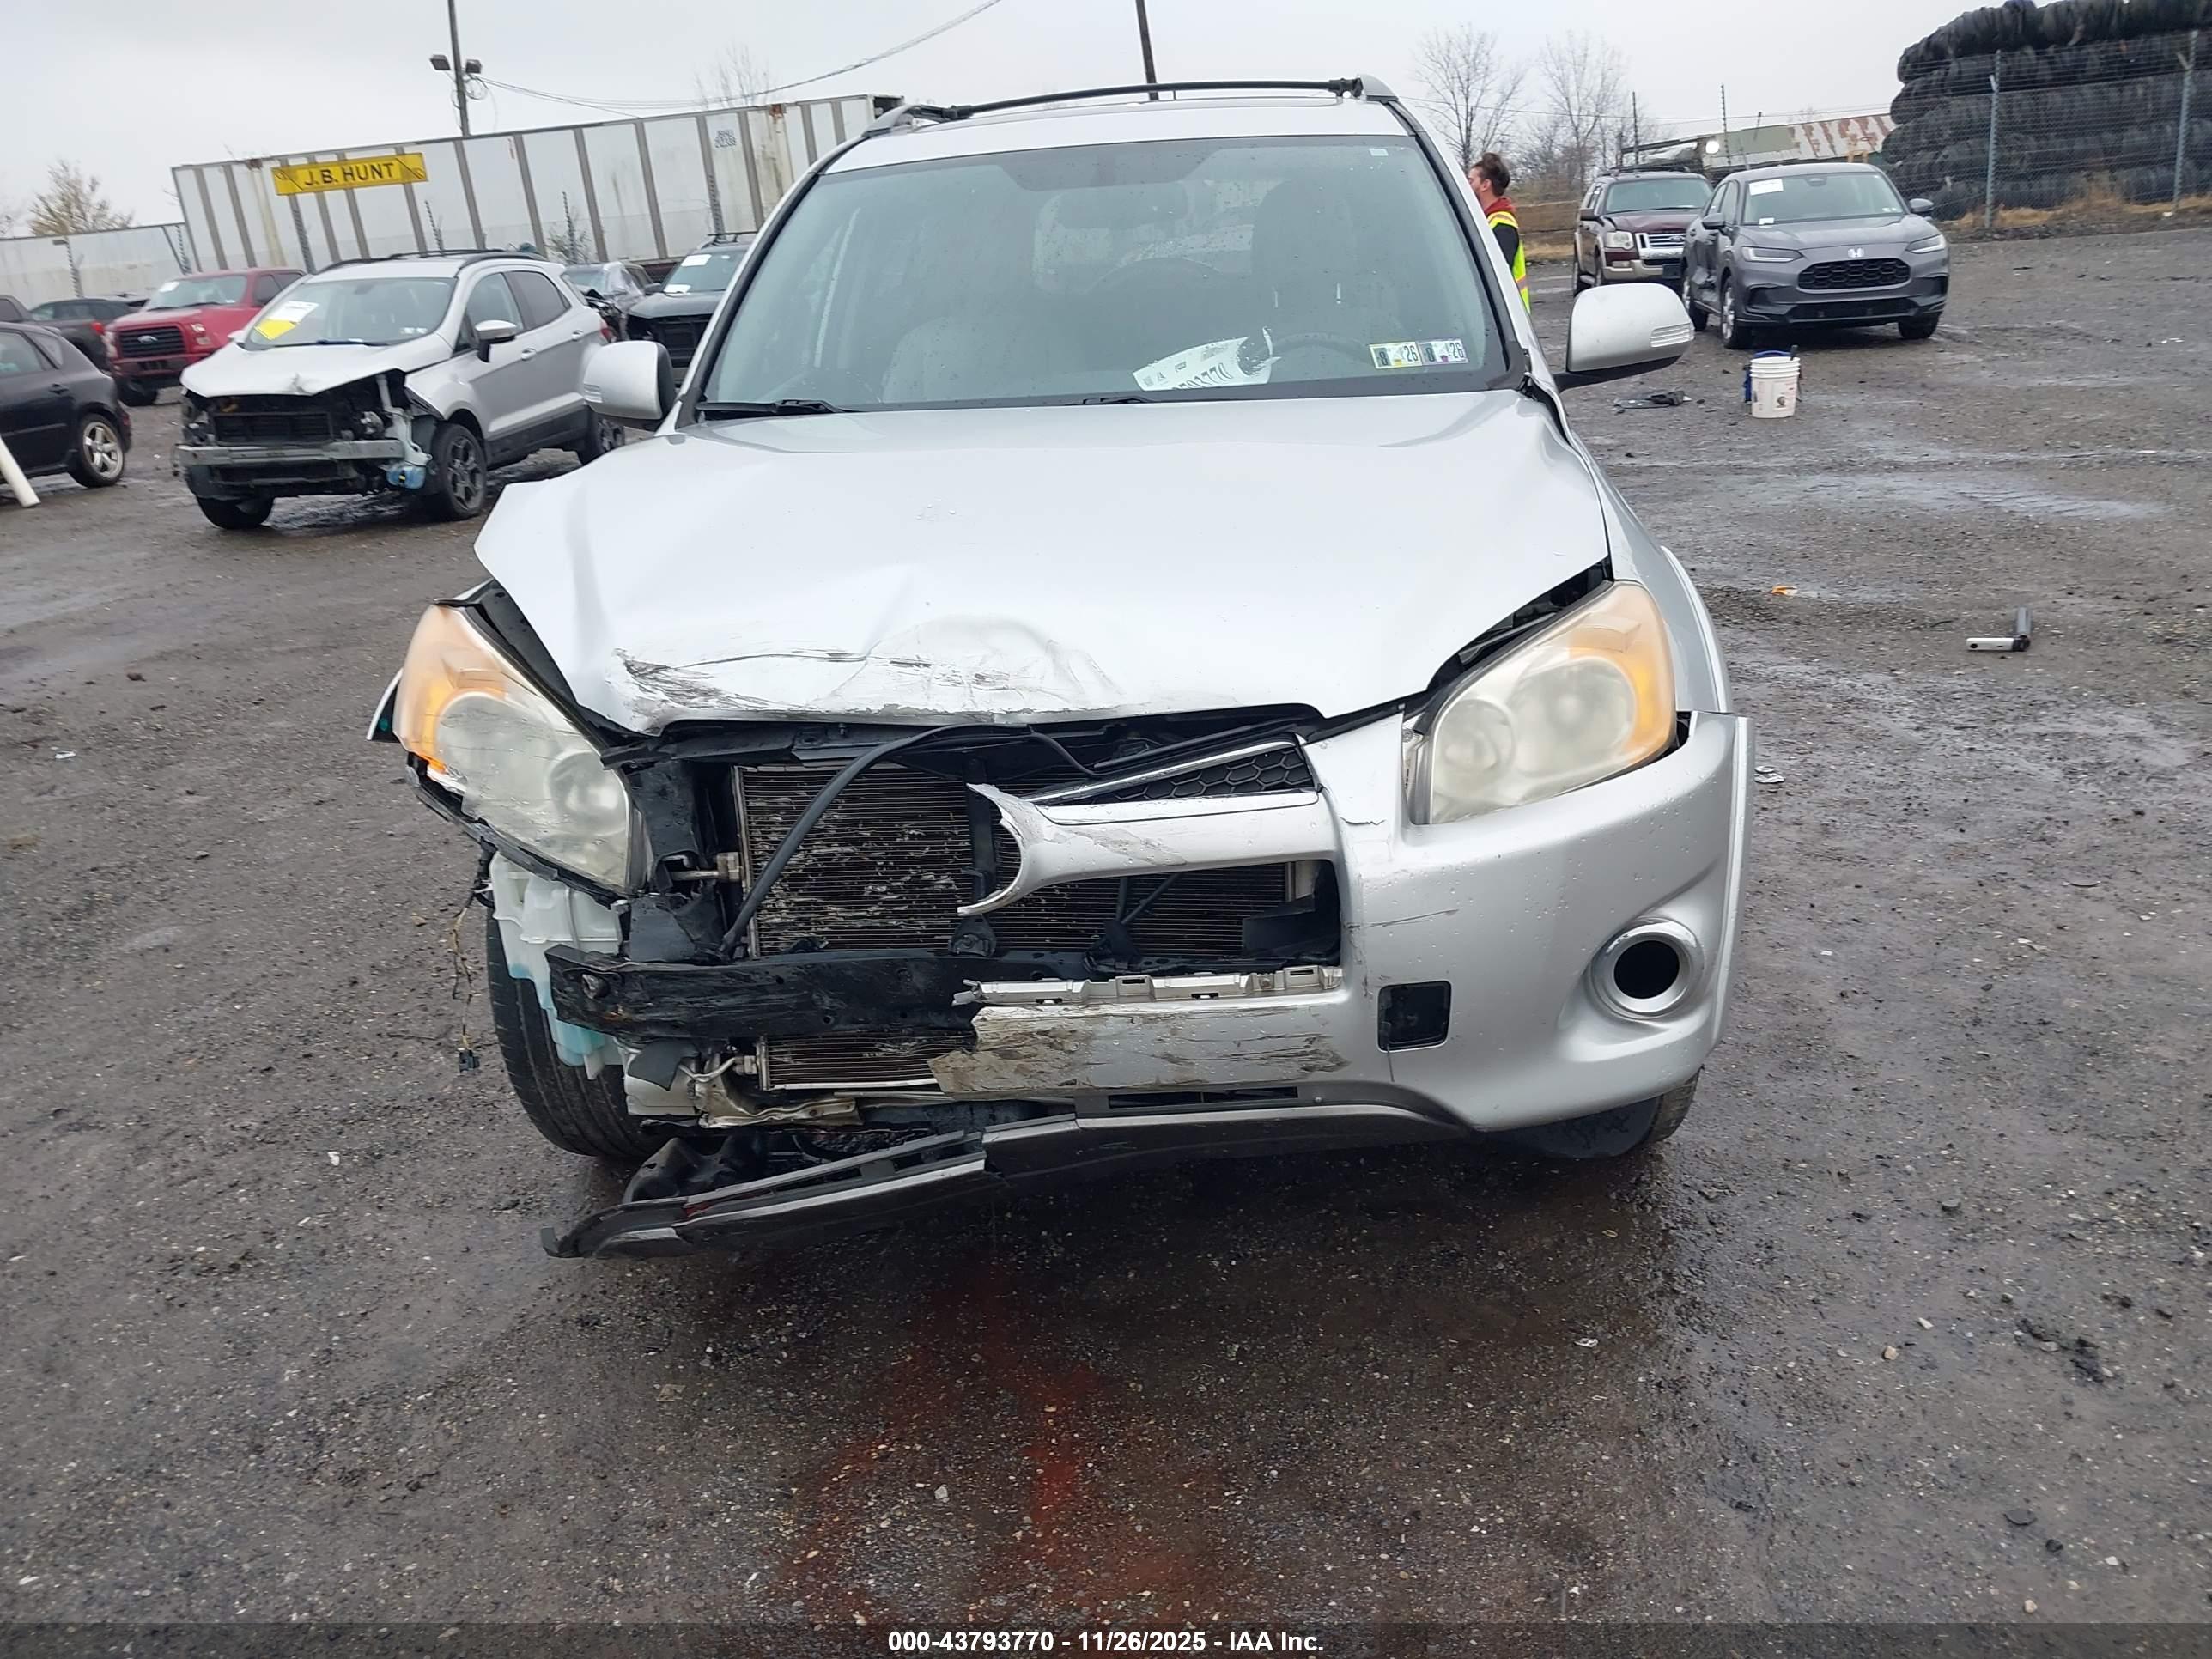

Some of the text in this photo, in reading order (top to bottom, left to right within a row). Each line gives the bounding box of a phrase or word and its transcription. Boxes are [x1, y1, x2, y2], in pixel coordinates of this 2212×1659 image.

[304, 162, 394, 186] J.B. HUNT
[1403, 345, 1419, 362] 26
[1449, 342, 1464, 358] 26
